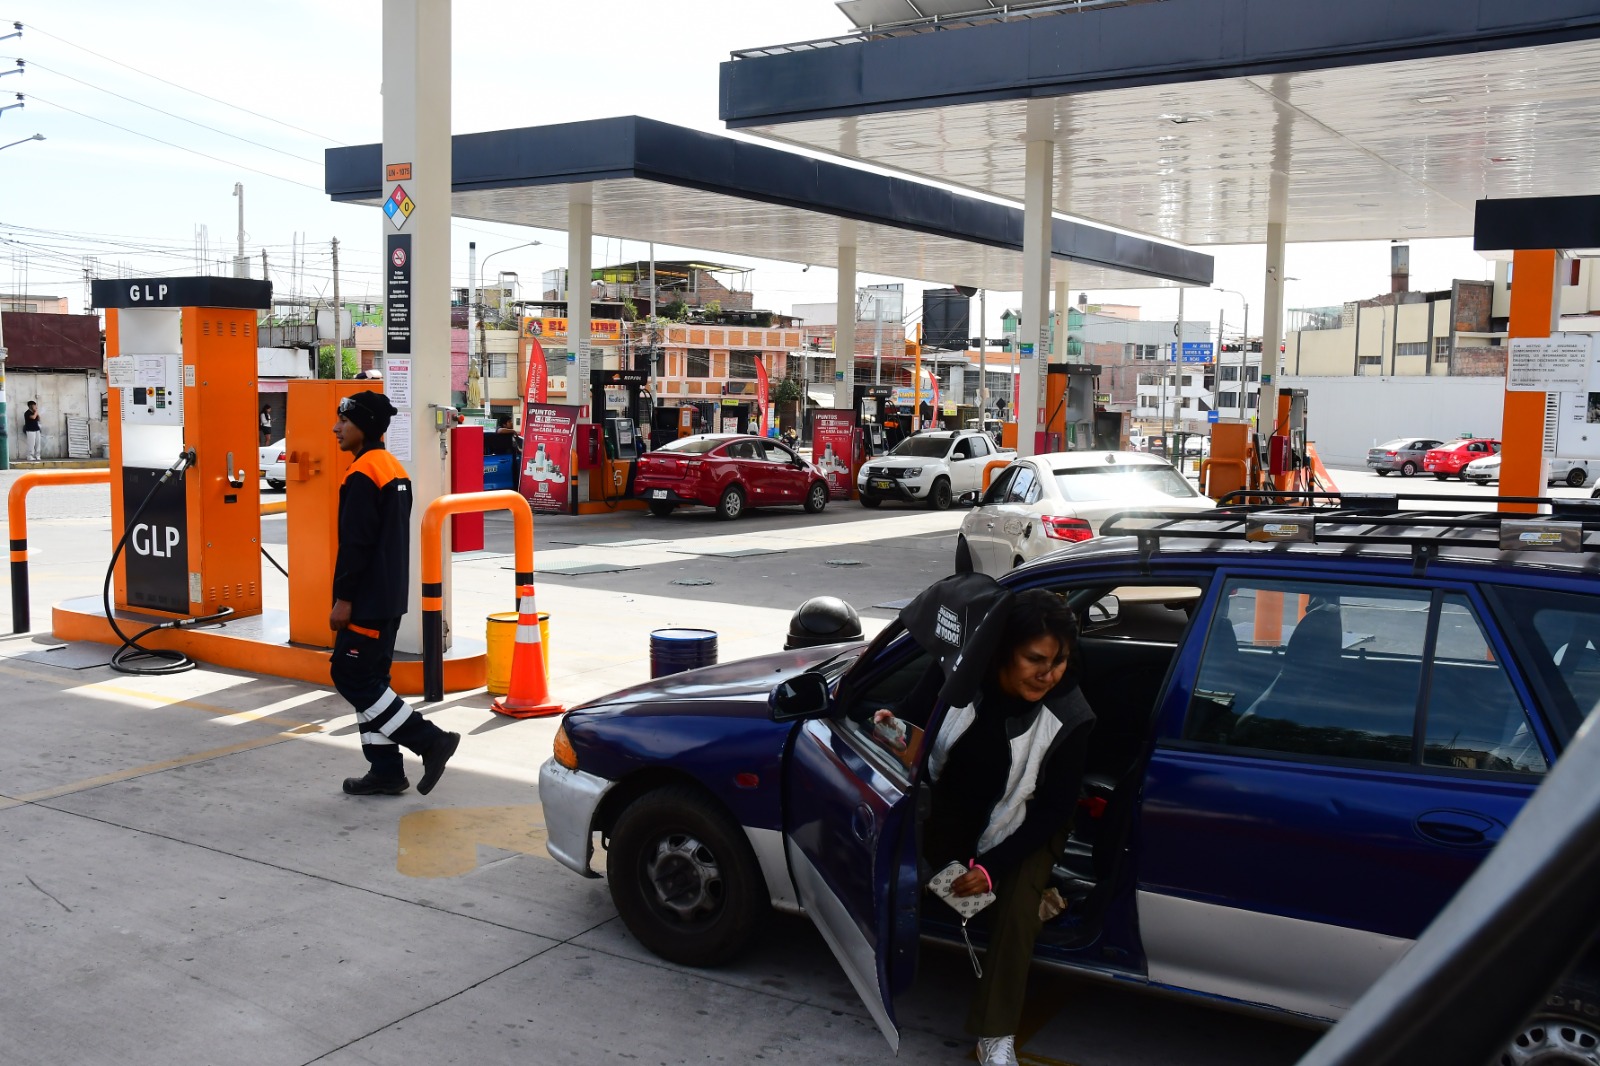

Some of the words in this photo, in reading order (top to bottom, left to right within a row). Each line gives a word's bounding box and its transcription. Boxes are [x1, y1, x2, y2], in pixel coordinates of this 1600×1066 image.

[396, 191, 401, 201] 4
[389, 203, 392, 212] 1
[405, 202, 409, 212] 0
[130, 284, 168, 301] GLP
[132, 523, 180, 557] GLP
